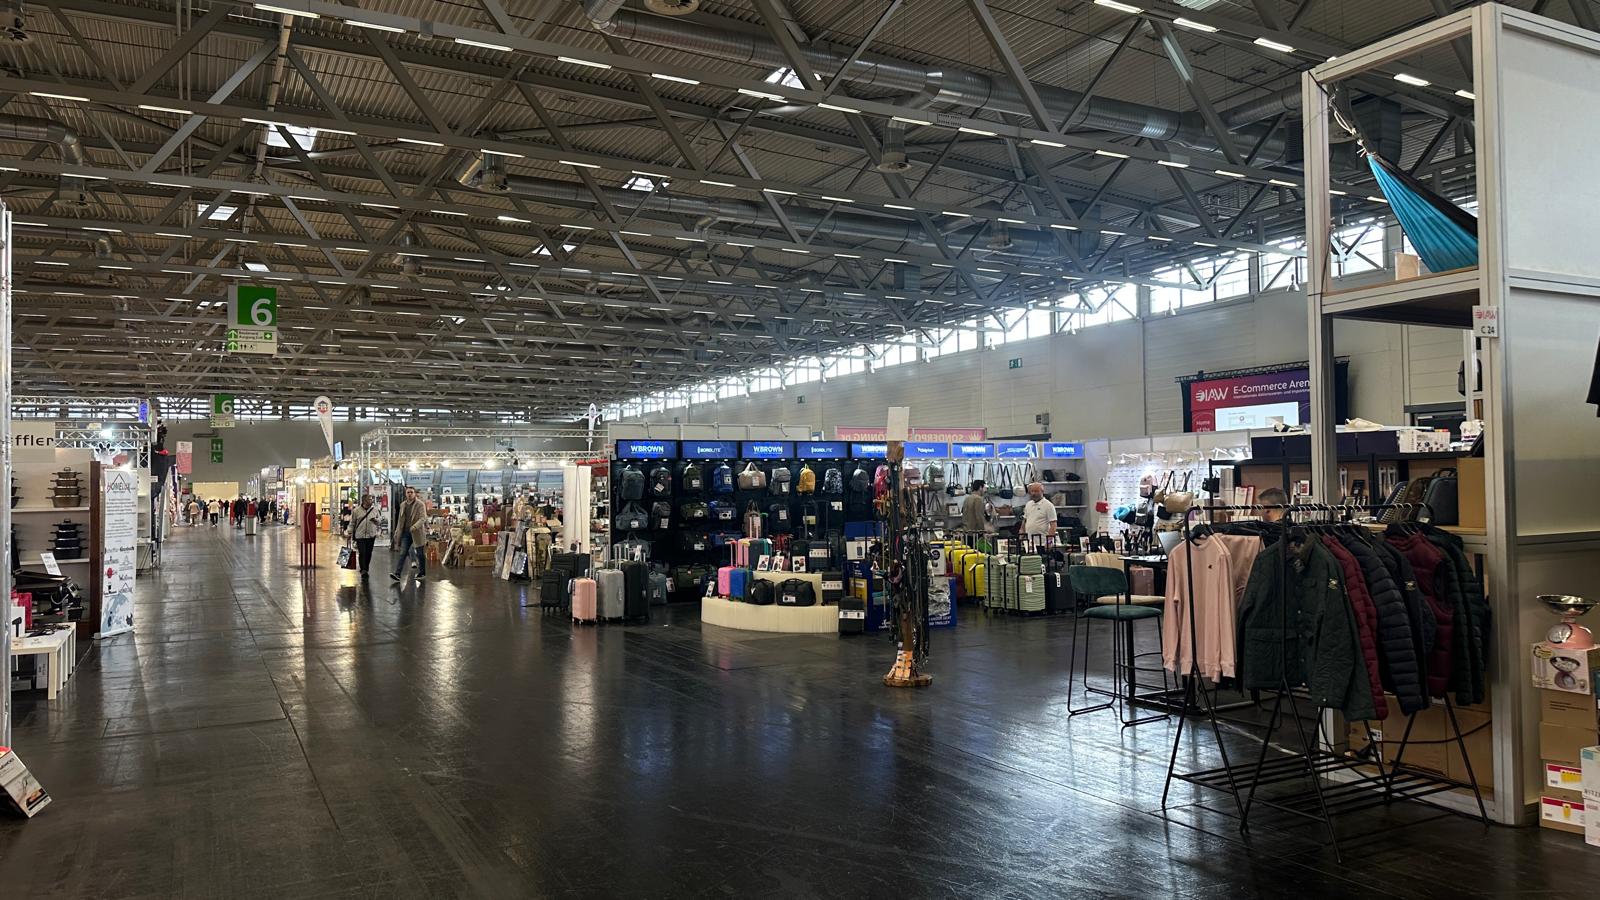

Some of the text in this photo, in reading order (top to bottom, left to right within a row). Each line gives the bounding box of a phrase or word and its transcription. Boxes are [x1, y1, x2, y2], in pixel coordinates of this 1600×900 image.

[251, 298, 272, 326] 6
[1481, 326, 1495, 334] C 24
[1233, 379, 1310, 394] E-Commerce Aren
[1205, 387, 1229, 401] IAW
[221, 400, 233, 414] 6
[11, 434, 54, 446] ffler
